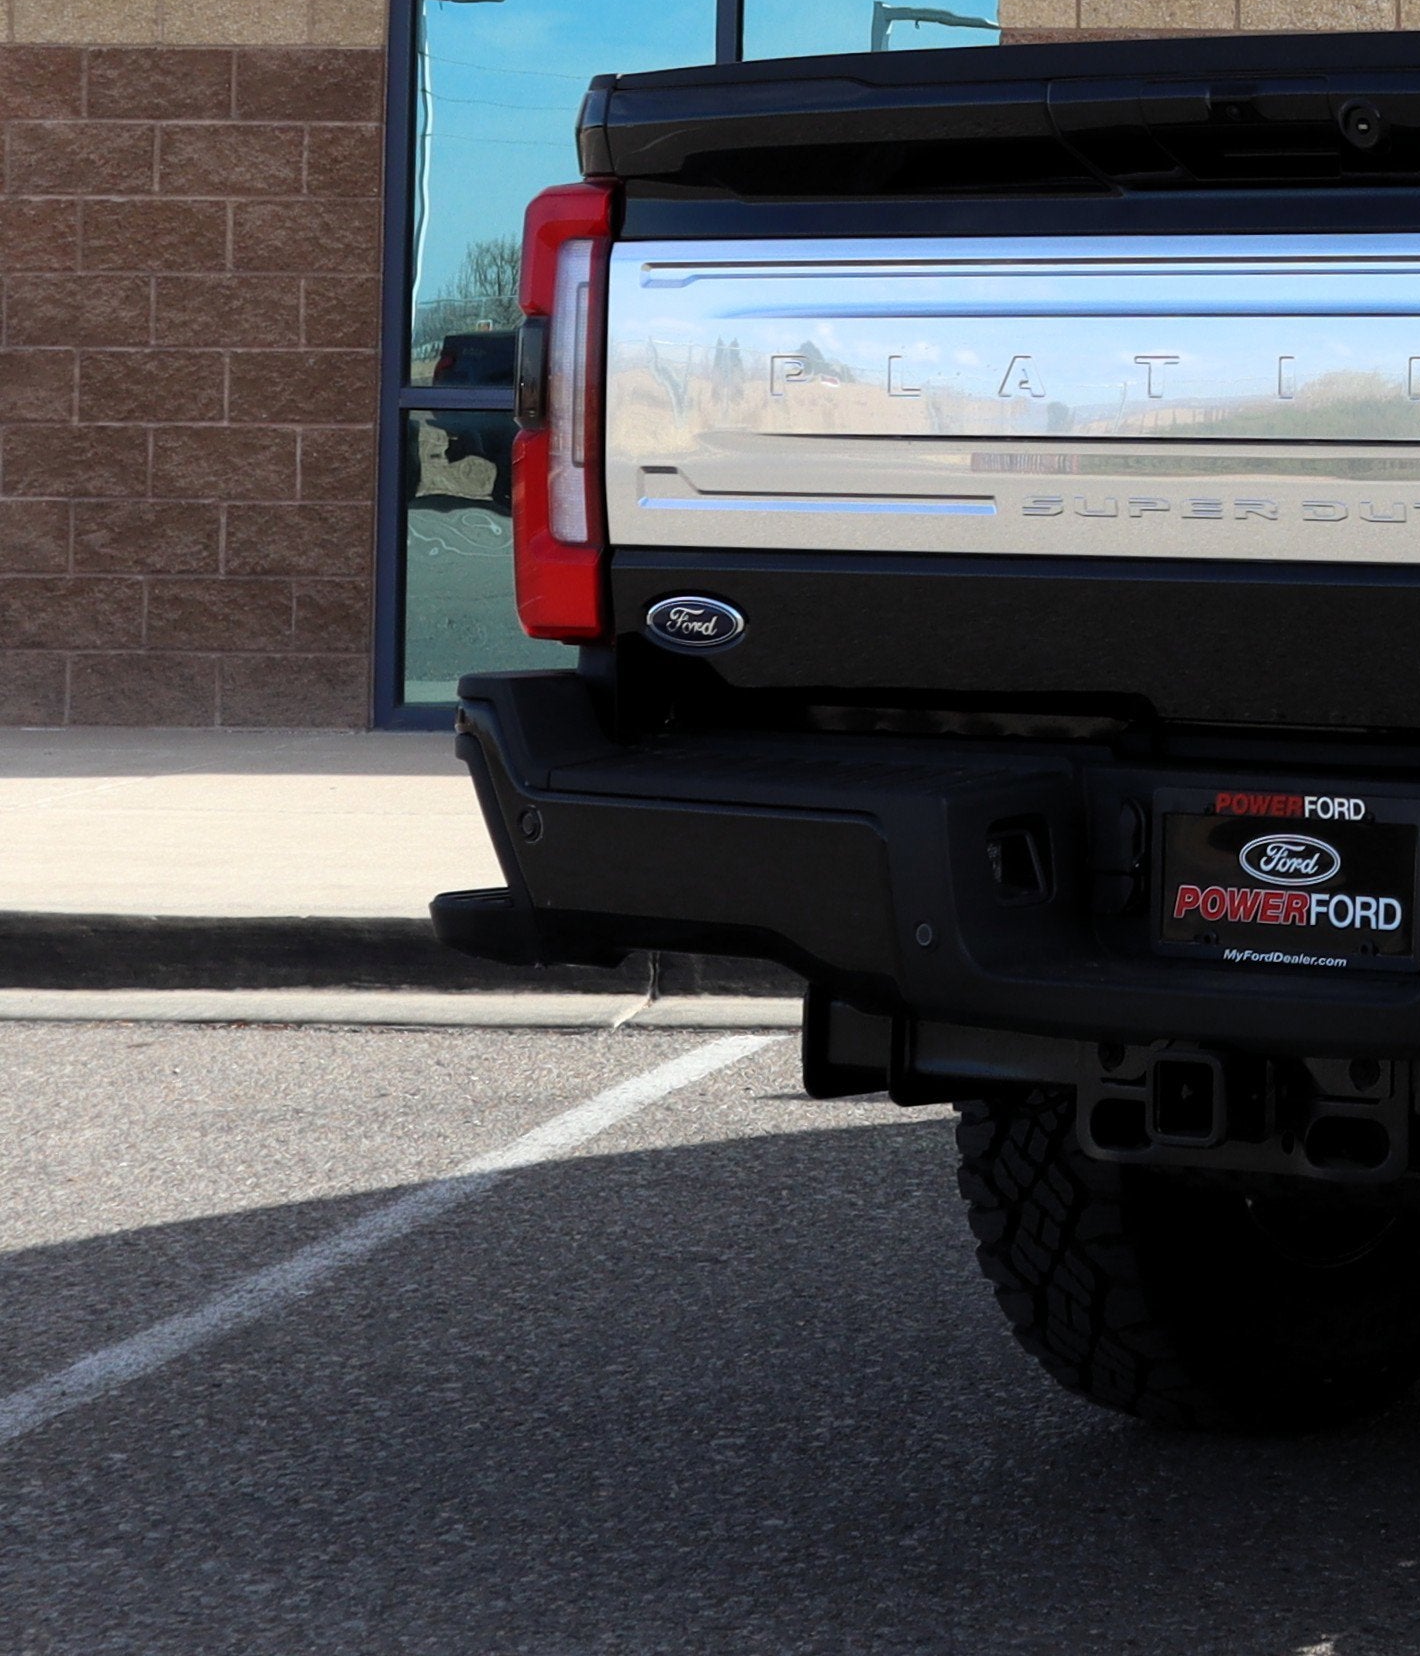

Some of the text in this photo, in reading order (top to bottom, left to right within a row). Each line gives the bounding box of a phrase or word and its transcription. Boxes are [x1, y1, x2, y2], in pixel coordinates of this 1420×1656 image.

[1021, 494, 1279, 522] SUPER
[666, 607, 718, 636] Ford
[1215, 793, 1366, 821] POWERFORD
[1260, 843, 1319, 875] Ford
[1174, 886, 1402, 931] POWERFORD
[1223, 948, 1347, 968] MyFordDealer.com
